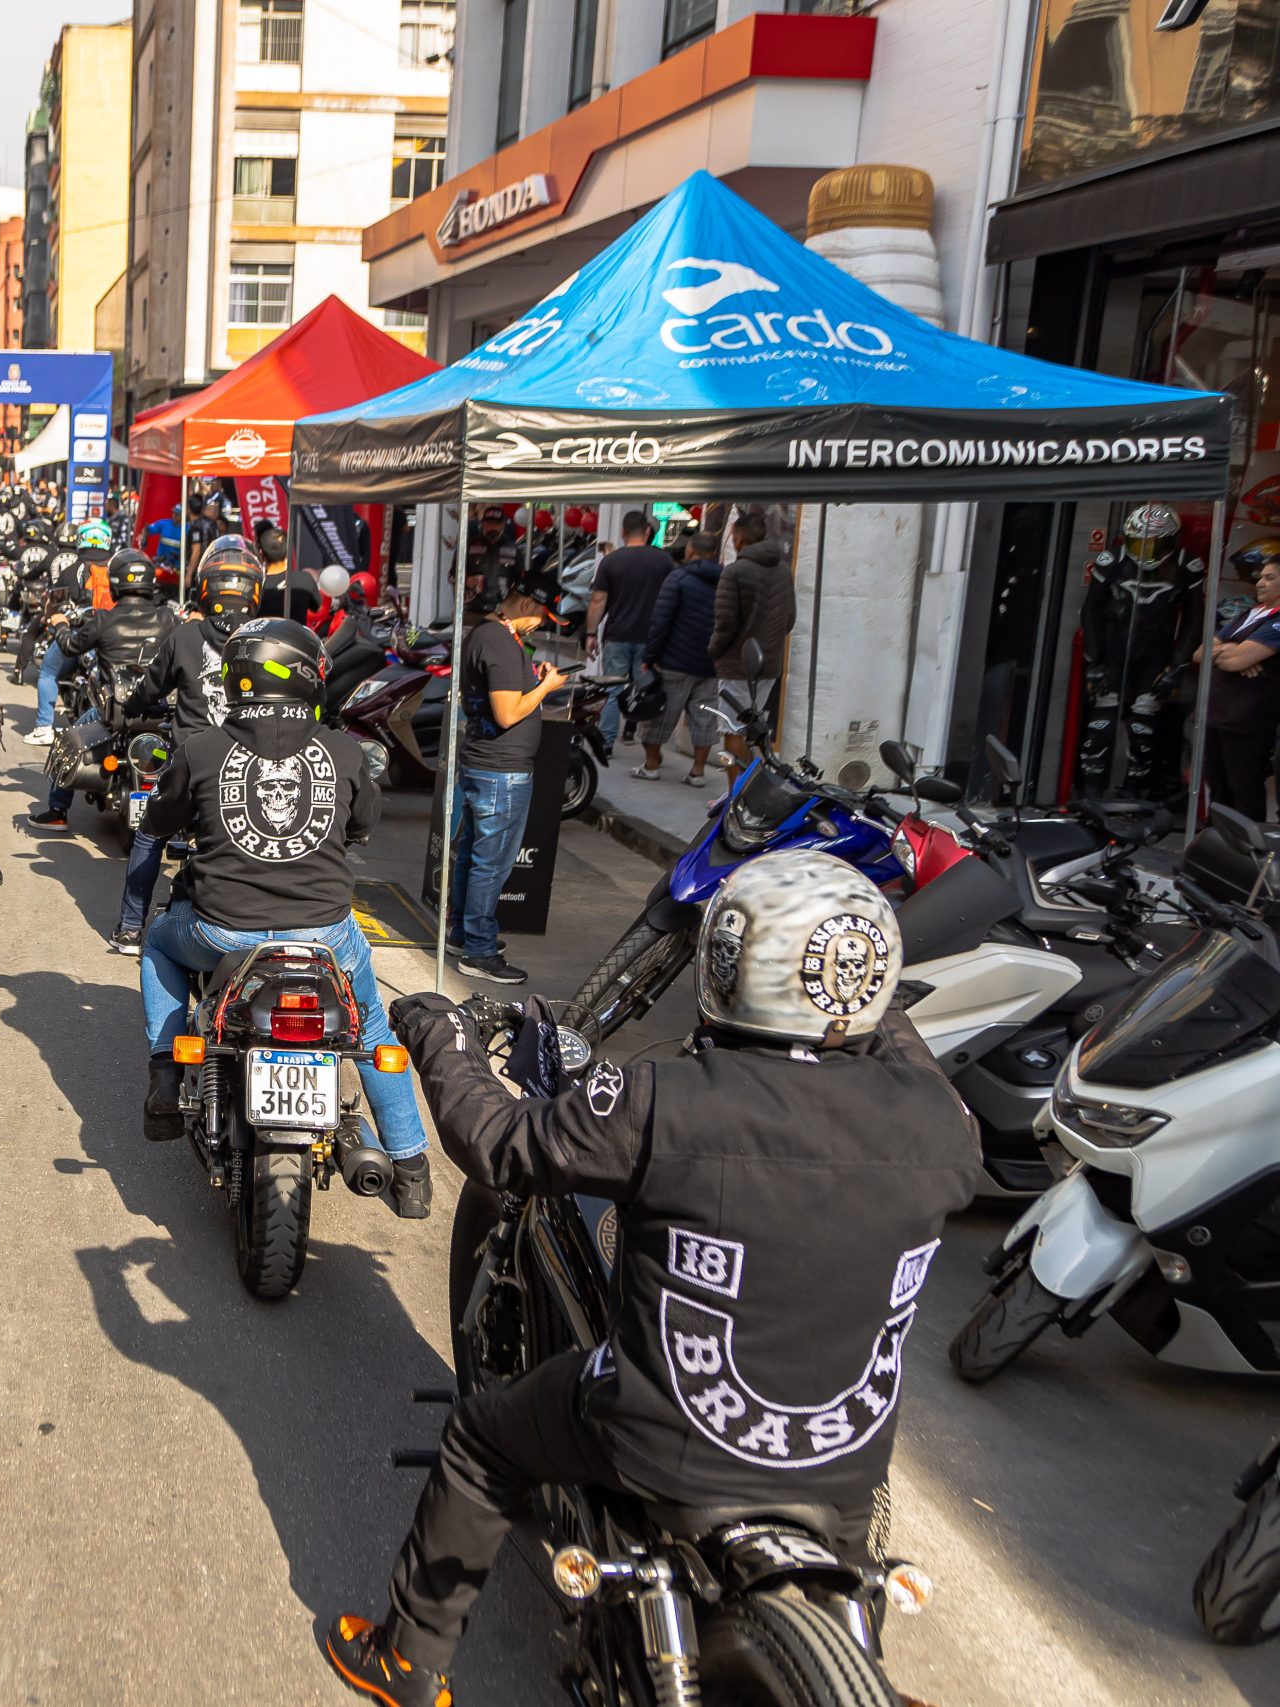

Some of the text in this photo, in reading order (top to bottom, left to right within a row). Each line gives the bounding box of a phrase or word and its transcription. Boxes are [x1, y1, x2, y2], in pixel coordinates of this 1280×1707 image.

[460, 174, 544, 238] HONDA
[660, 308, 893, 355] cardo
[339, 440, 455, 474] INTERCOMUNICADORES
[552, 430, 664, 465] cardo
[787, 436, 1207, 469] INTERCOMUNICADORES
[239, 705, 275, 719] SINCE
[223, 786, 241, 802] 18
[313, 786, 336, 801] MC
[228, 814, 330, 858] BRASIL
[497, 892, 526, 901] uetooth
[808, 916, 887, 955] INSANOS
[804, 957, 820, 971] 18
[805, 980, 882, 1015] BRASIL
[277, 1056, 310, 1065] BRASIL
[269, 1065, 318, 1091] KQN
[261, 1090, 327, 1117] 3H65
[681, 1240, 728, 1285] 18
[673, 1330, 900, 1458] BRASIL
[751, 1536, 839, 1566] 18
